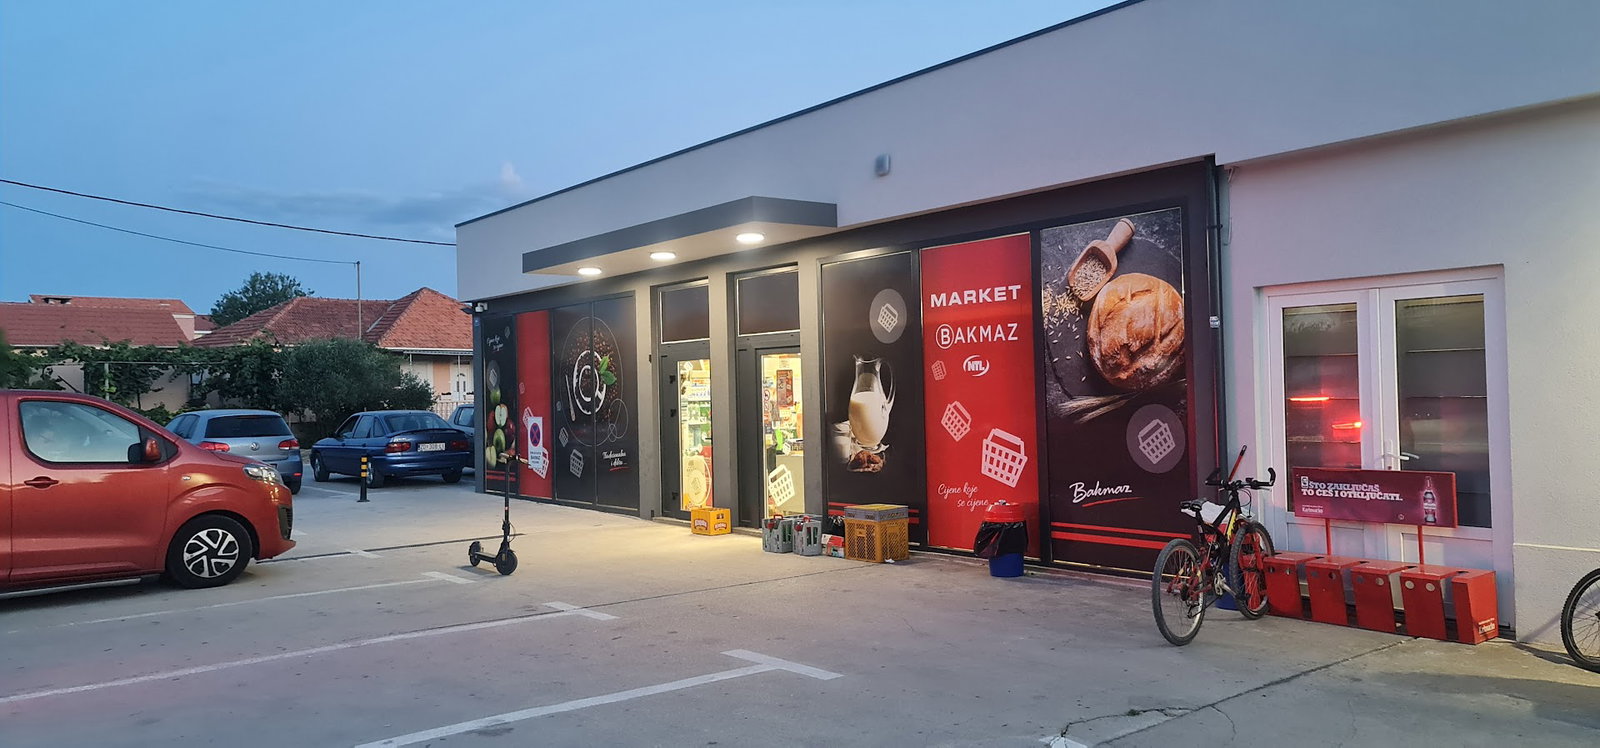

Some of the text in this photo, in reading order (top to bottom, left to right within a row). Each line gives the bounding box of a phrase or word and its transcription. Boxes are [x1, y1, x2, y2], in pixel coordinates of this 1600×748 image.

[930, 285, 1021, 308] MARKET
[936, 323, 1019, 349] BAKMAZ
[967, 360, 985, 372] NTL
[938, 482, 977, 499] Cijene koje
[1069, 481, 1132, 503] Bakmaz
[1308, 481, 1326, 490] ŠTO
[1334, 490, 1339, 498] I
[967, 499, 988, 512] cijene
